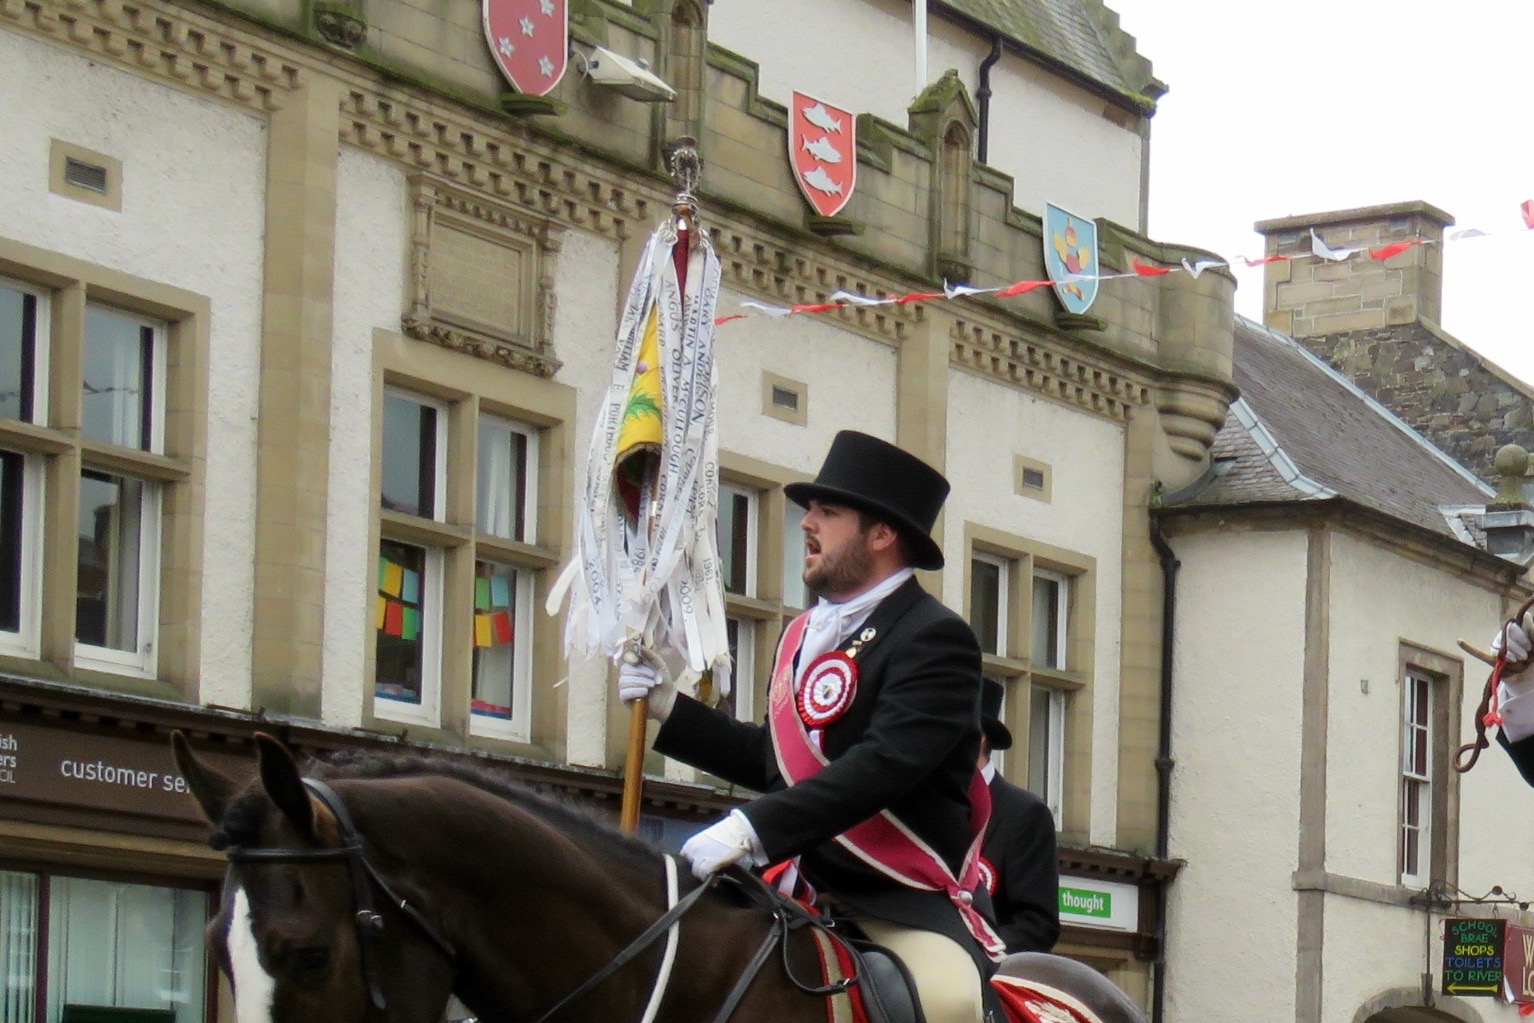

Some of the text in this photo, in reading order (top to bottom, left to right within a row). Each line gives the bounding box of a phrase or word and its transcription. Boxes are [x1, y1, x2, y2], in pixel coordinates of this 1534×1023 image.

[666, 280, 680, 332] ANGUS
[61, 760, 158, 789] customer
[1062, 891, 1105, 914] thought
[1452, 921, 1498, 938] SCHOOL
[1460, 934, 1489, 943] BRAE
[1454, 945, 1494, 956] SHOPS
[1446, 957, 1501, 969] TOILETS
[1445, 970, 1502, 982] TO RIVER
